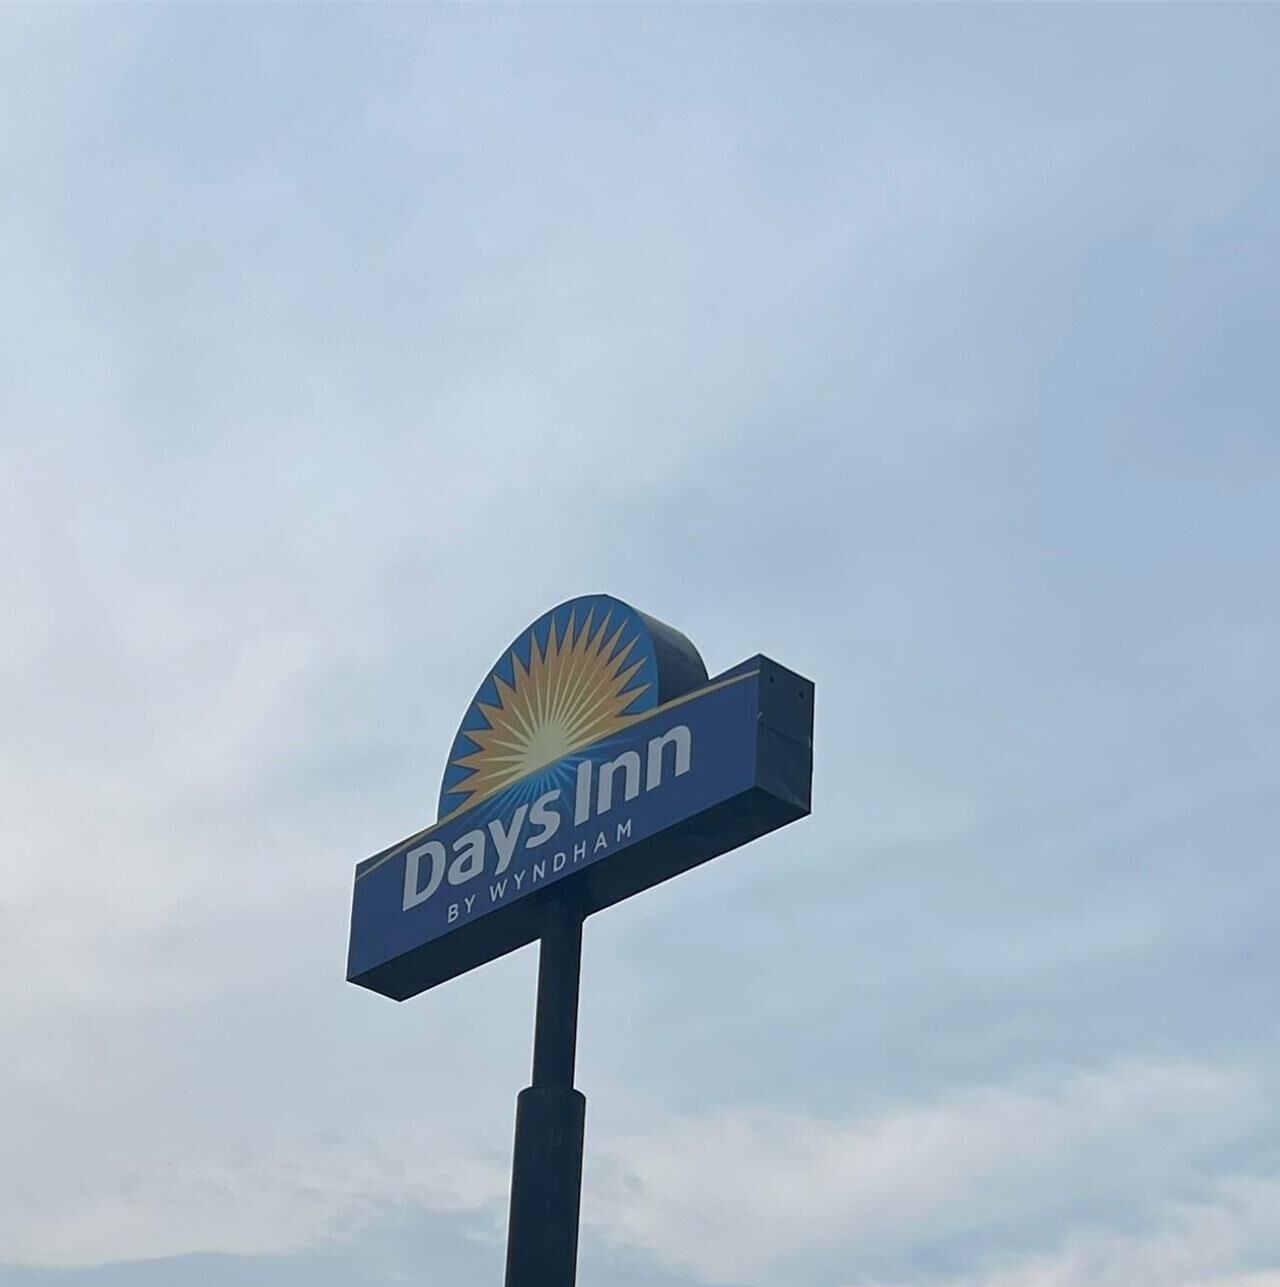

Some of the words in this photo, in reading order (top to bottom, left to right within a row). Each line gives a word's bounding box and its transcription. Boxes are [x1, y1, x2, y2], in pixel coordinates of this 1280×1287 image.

[402, 789, 562, 912] Days
[574, 724, 692, 827] Inn
[447, 894, 476, 924] BY
[489, 818, 633, 902] WYNDHAM
